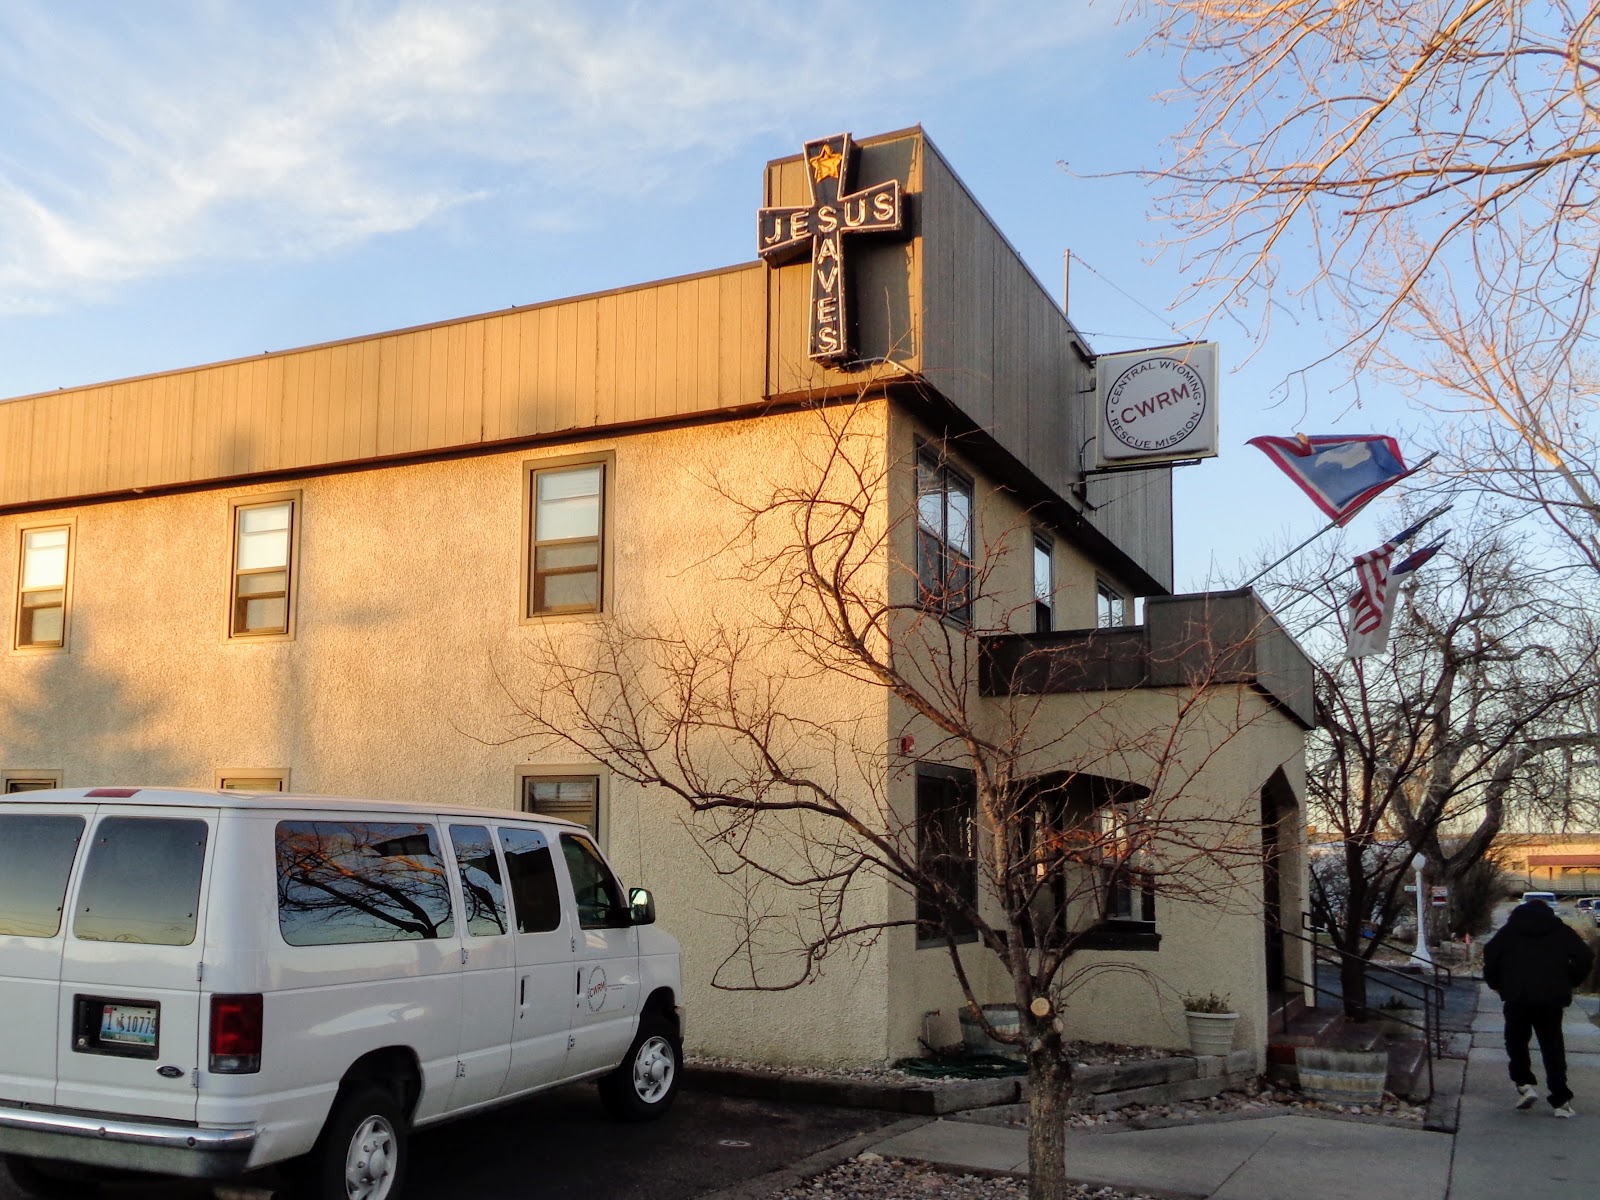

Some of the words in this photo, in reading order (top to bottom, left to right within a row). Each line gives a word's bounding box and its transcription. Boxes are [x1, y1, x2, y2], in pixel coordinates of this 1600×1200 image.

[765, 193, 894, 244] JESUS
[1111, 362, 1156, 405] CENTRAL
[1159, 360, 1201, 400] WYOMING
[1120, 383, 1191, 424] CWRM
[1110, 418, 1151, 449] RESCUE
[1155, 412, 1200, 449] MISSION
